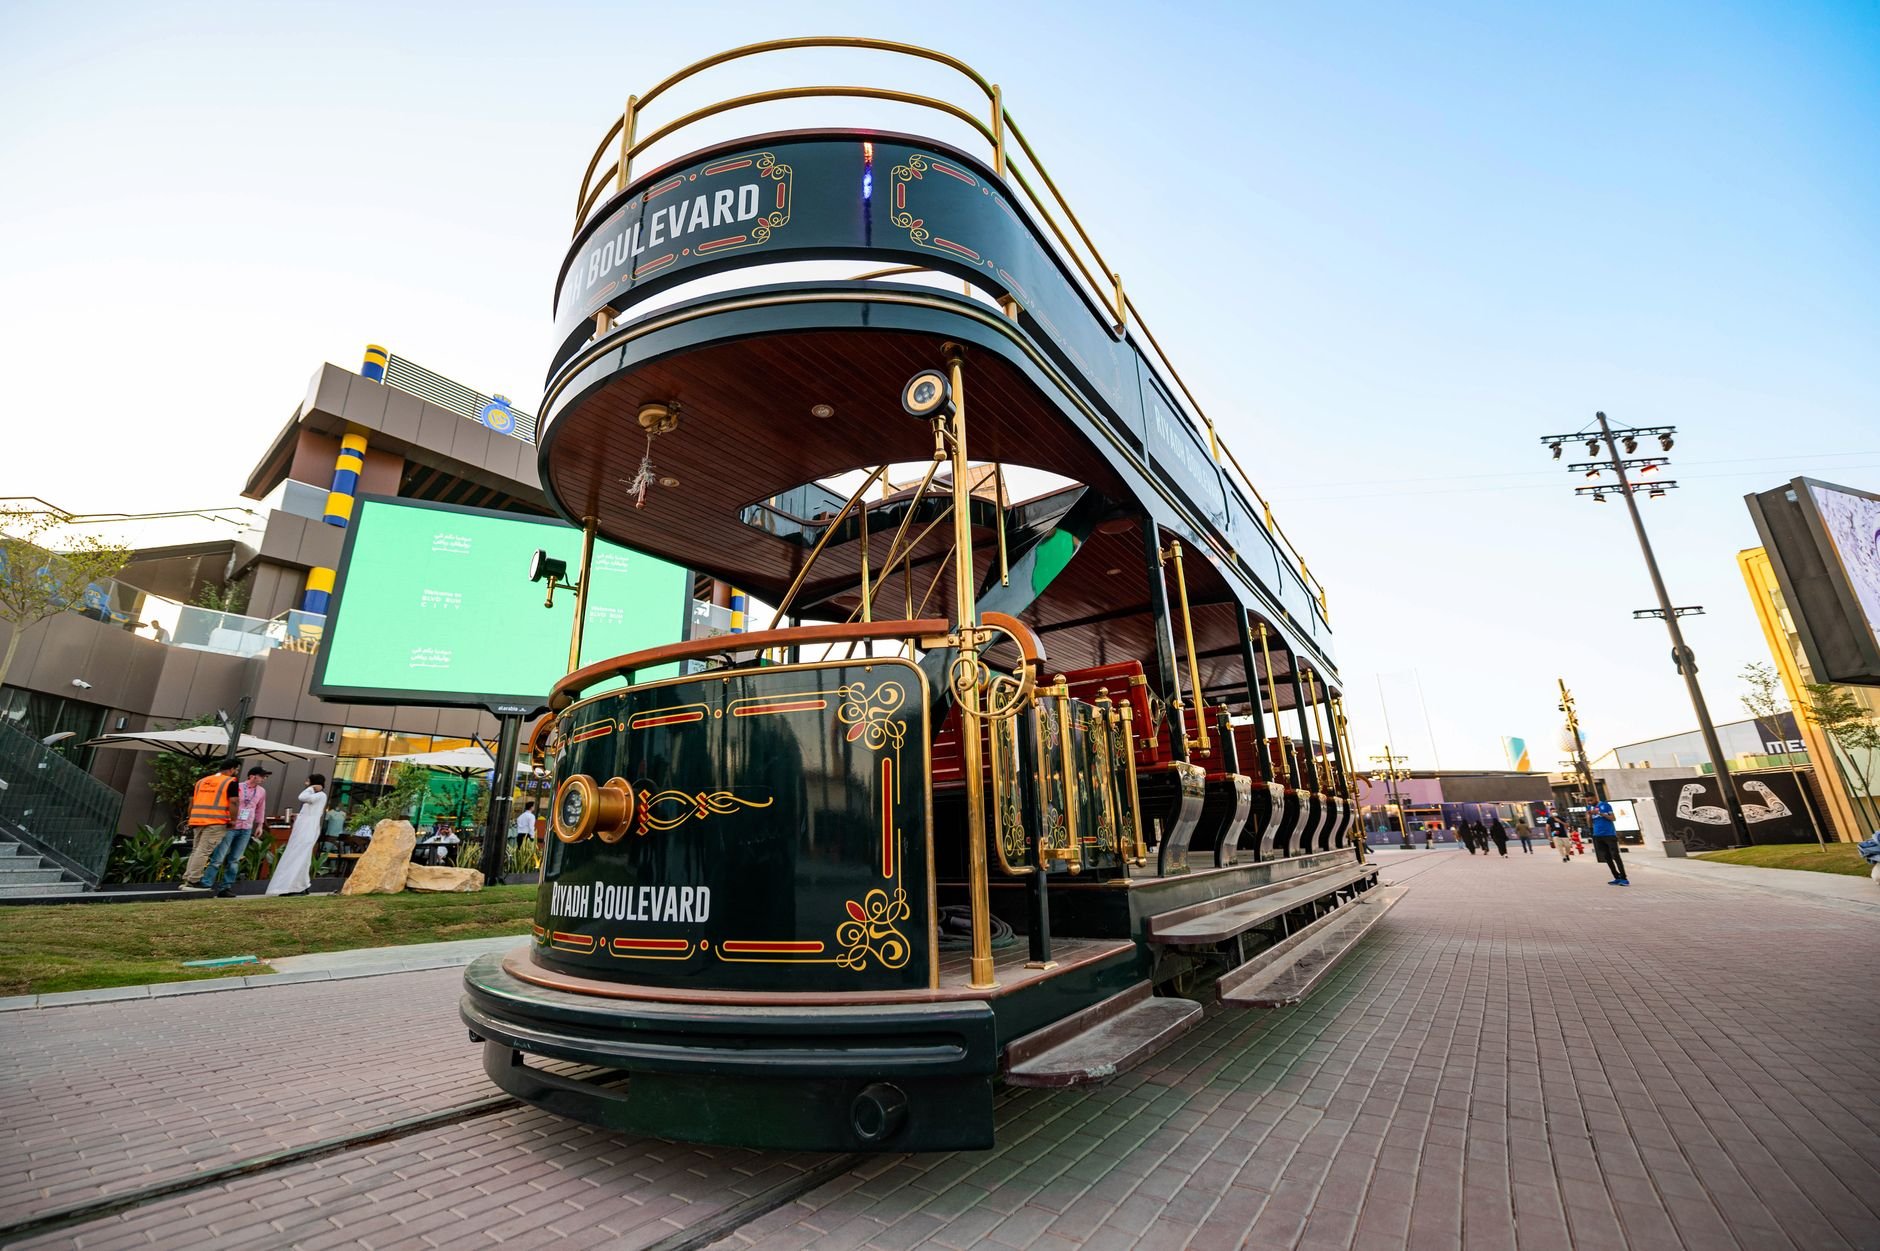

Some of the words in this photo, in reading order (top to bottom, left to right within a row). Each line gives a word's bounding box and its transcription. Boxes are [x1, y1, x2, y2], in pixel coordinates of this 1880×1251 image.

[585, 183, 760, 291] BOULEVARD
[550, 881, 590, 918] RIYADH
[593, 880, 711, 923] BOULEVARD
